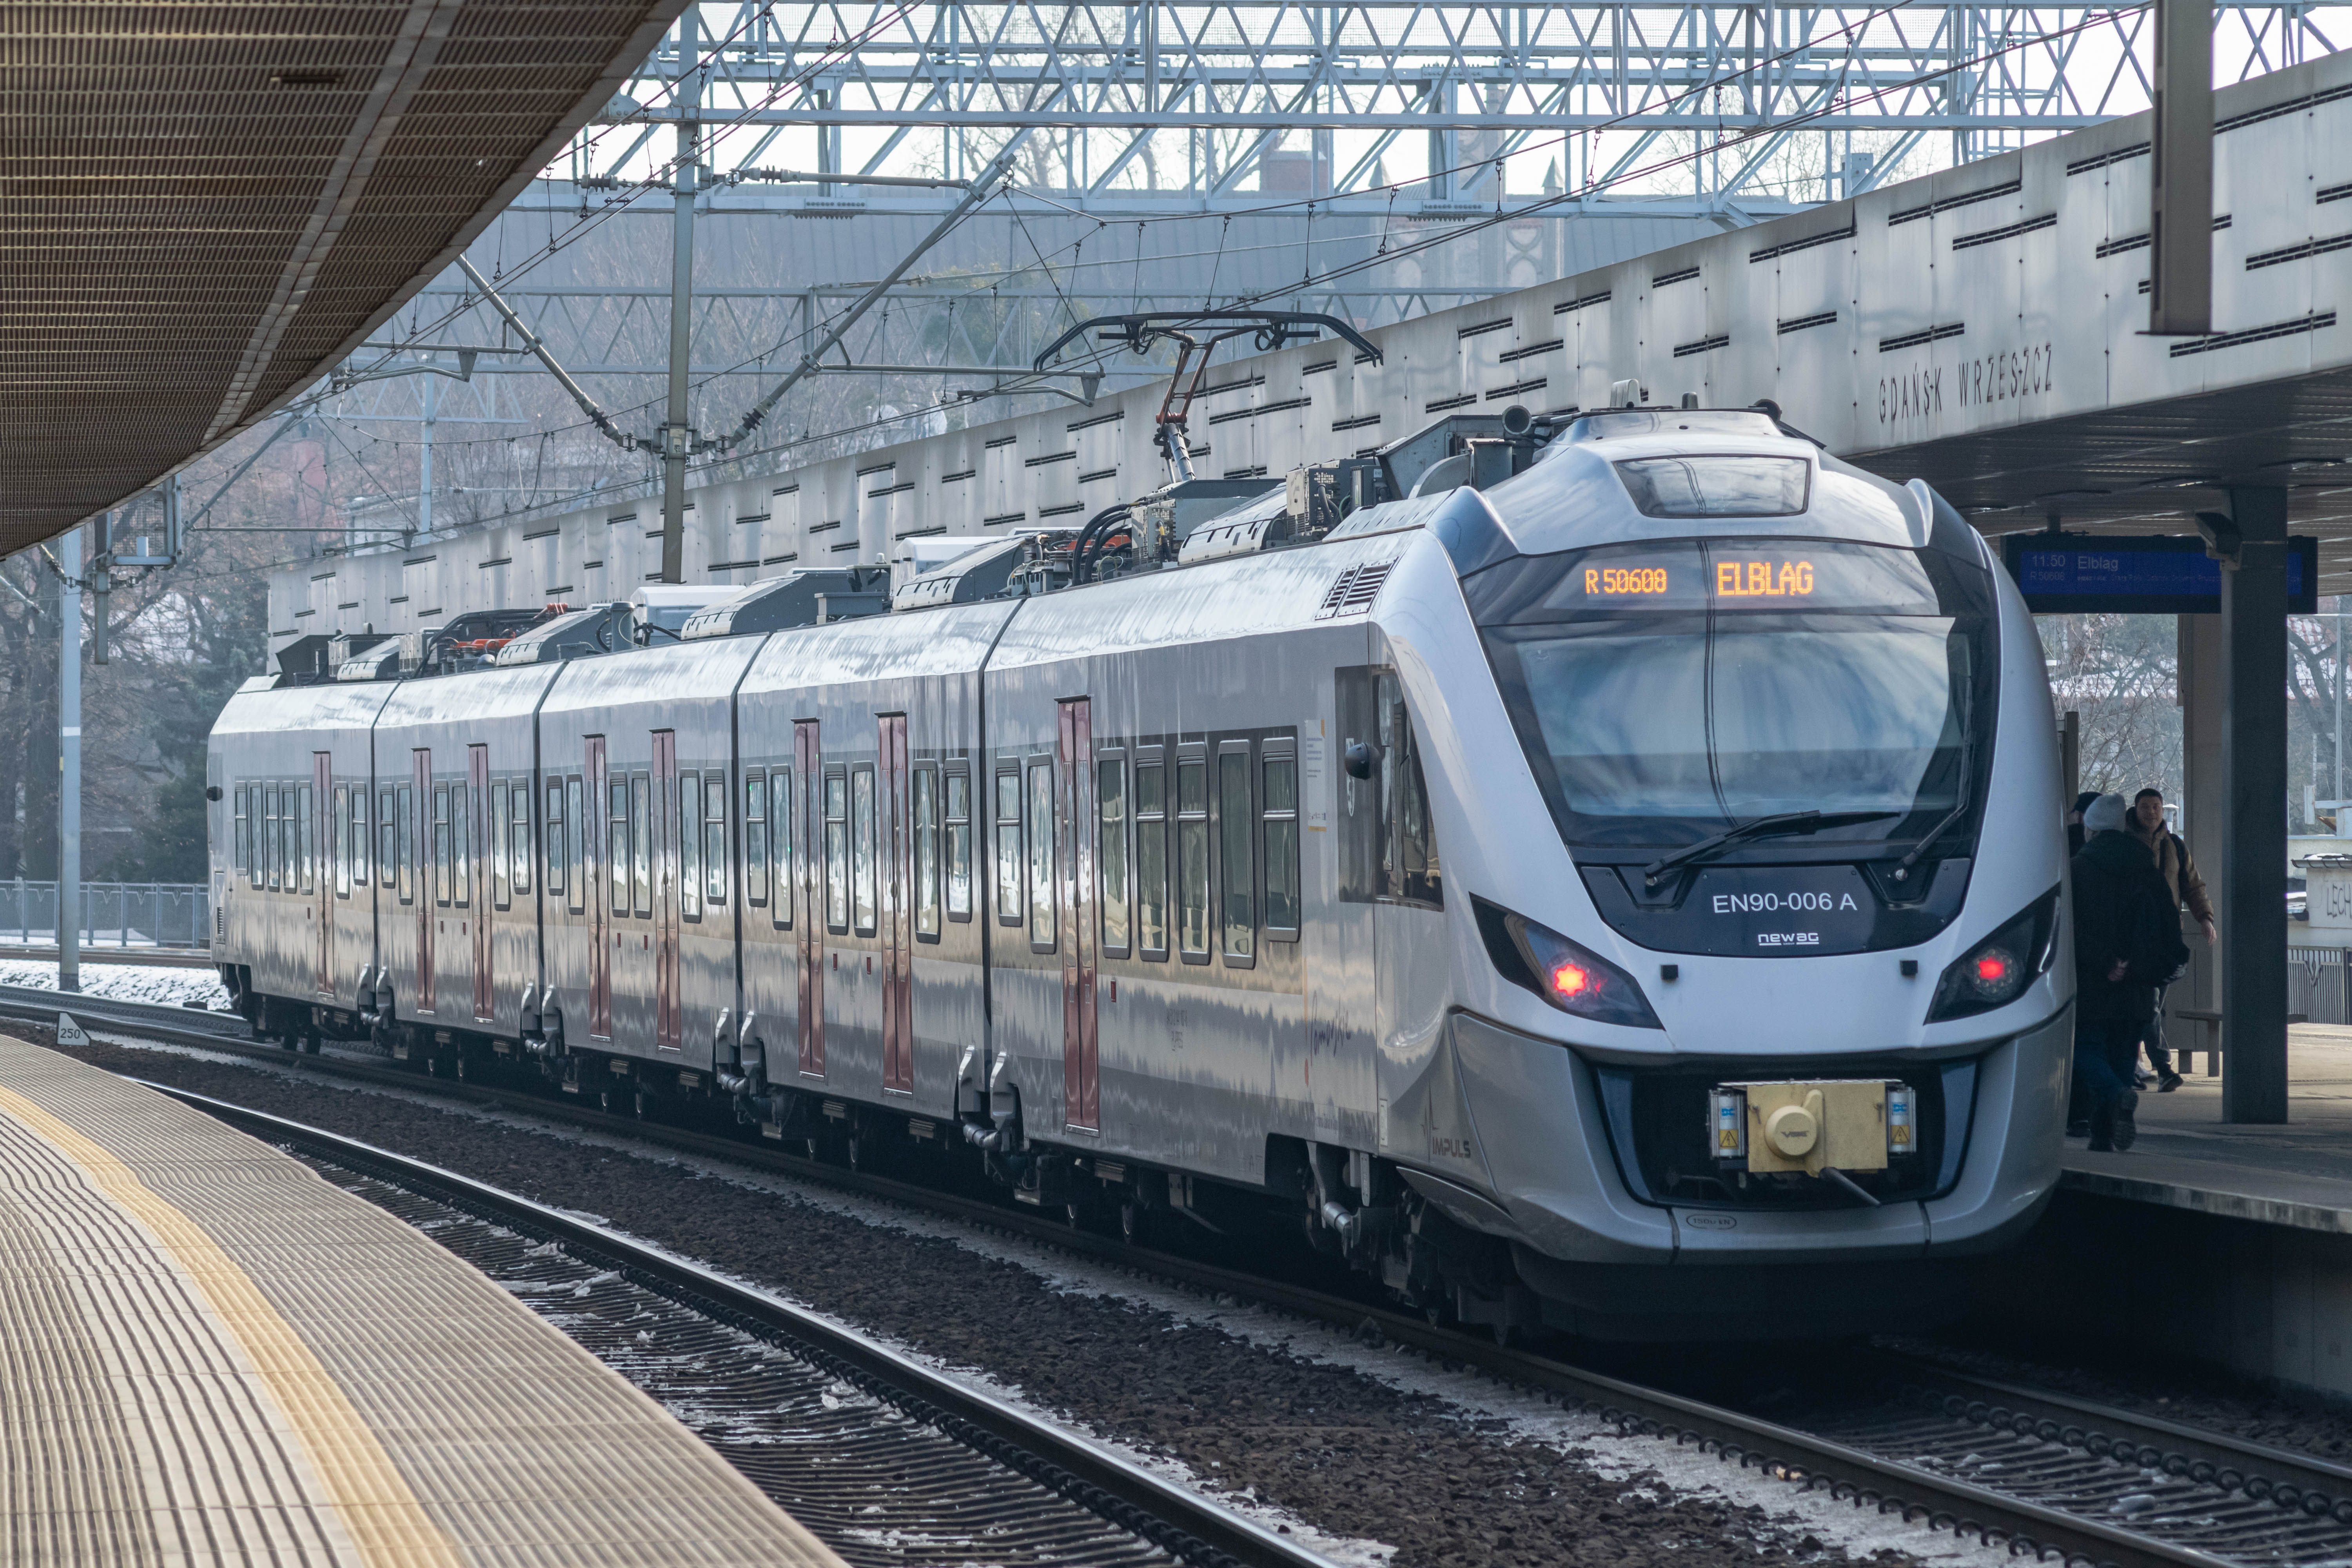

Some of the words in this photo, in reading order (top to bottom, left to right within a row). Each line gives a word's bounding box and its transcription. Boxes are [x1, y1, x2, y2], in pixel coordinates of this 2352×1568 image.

[1879, 363, 1942, 423] GDAŃSK
[1958, 340, 2051, 407] WRZESZCZ
[1585, 569, 1598, 594] R
[1604, 568, 1667, 593] 50608
[1717, 561, 1813, 596] ELBLĄG
[1713, 893, 1833, 913] EN90-006
[1840, 893, 1857, 911] A
[60, 1028, 80, 1039] 250
[1433, 1137, 1470, 1158] IMPULS
